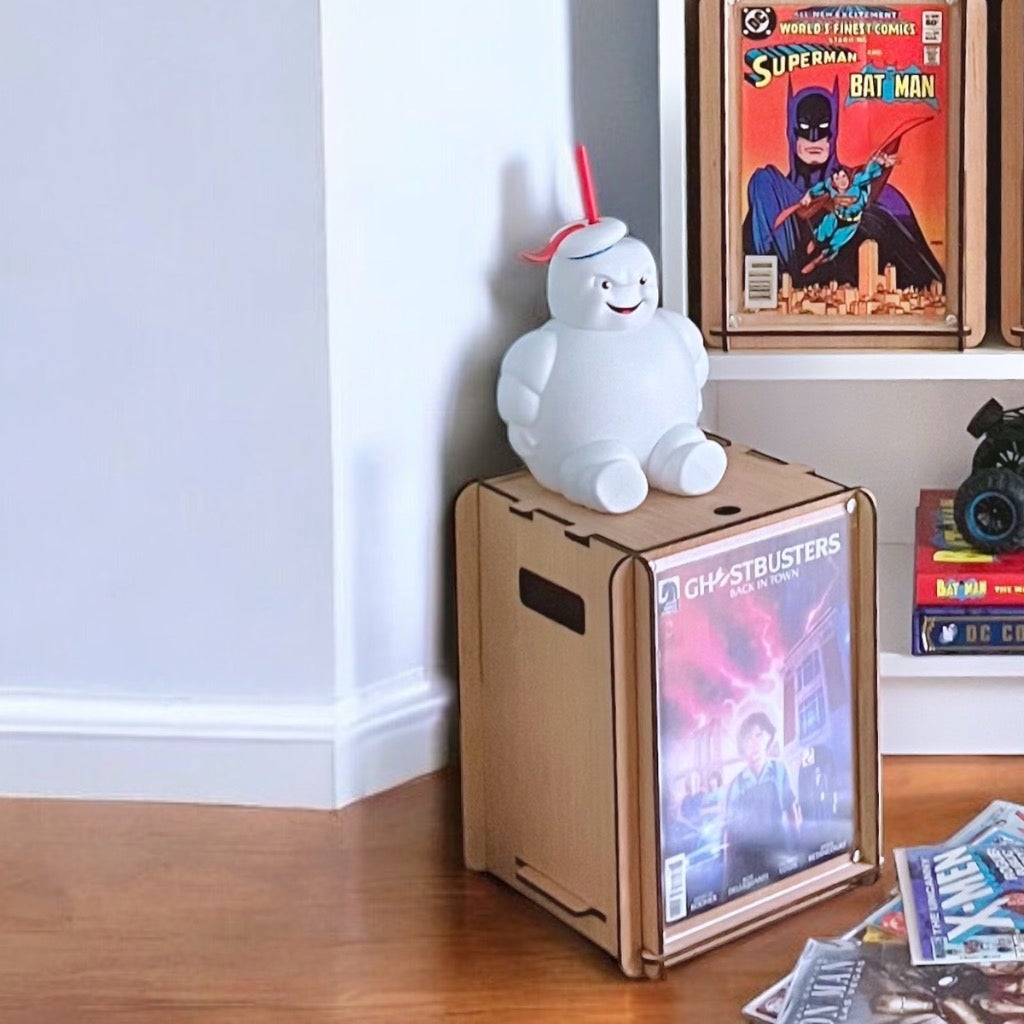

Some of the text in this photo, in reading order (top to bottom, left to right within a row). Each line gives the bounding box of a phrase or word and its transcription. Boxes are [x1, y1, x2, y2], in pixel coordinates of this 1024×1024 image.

[748, 12, 767, 31] DC
[833, 23, 871, 36] FINEST
[875, 23, 916, 36] COMICS
[752, 50, 857, 88] SUPERMAN
[684, 532, 842, 600] GHOSTBUSTERS
[729, 568, 801, 599] BACK IN TOWN
[994, 585, 1012, 594] THE
[965, 624, 992, 643] DC
[920, 856, 941, 935] THE UNCANNY
[933, 846, 1015, 942] X-MEN
[810, 961, 856, 998] MAN
[837, 960, 866, 1021] LAS VEGAS
